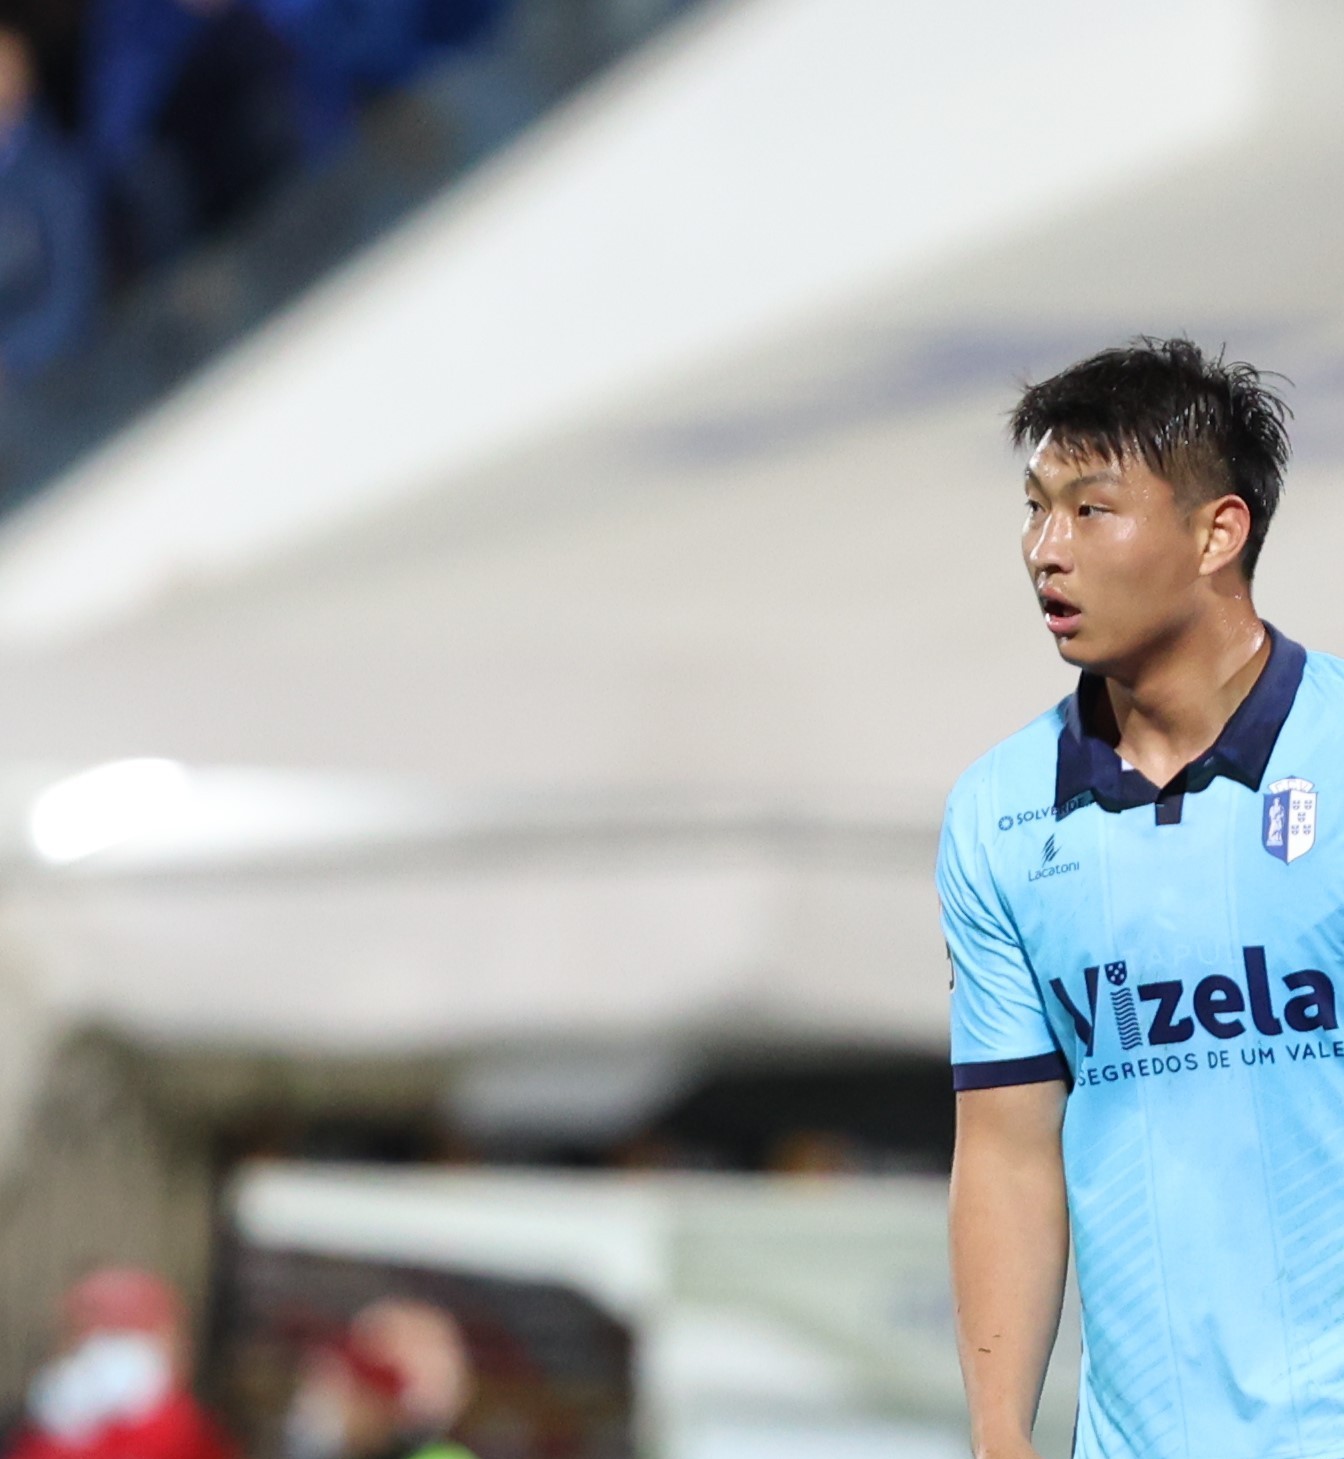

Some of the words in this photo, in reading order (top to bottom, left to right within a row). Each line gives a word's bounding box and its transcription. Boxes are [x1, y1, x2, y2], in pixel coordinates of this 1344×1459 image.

[1028, 861, 1080, 882] Lacatoni
[1049, 945, 1339, 1057] Vizela
[1077, 1052, 1198, 1086] SEGREDOS
[1207, 1050, 1231, 1069] DE
[1241, 1044, 1275, 1066] UM
